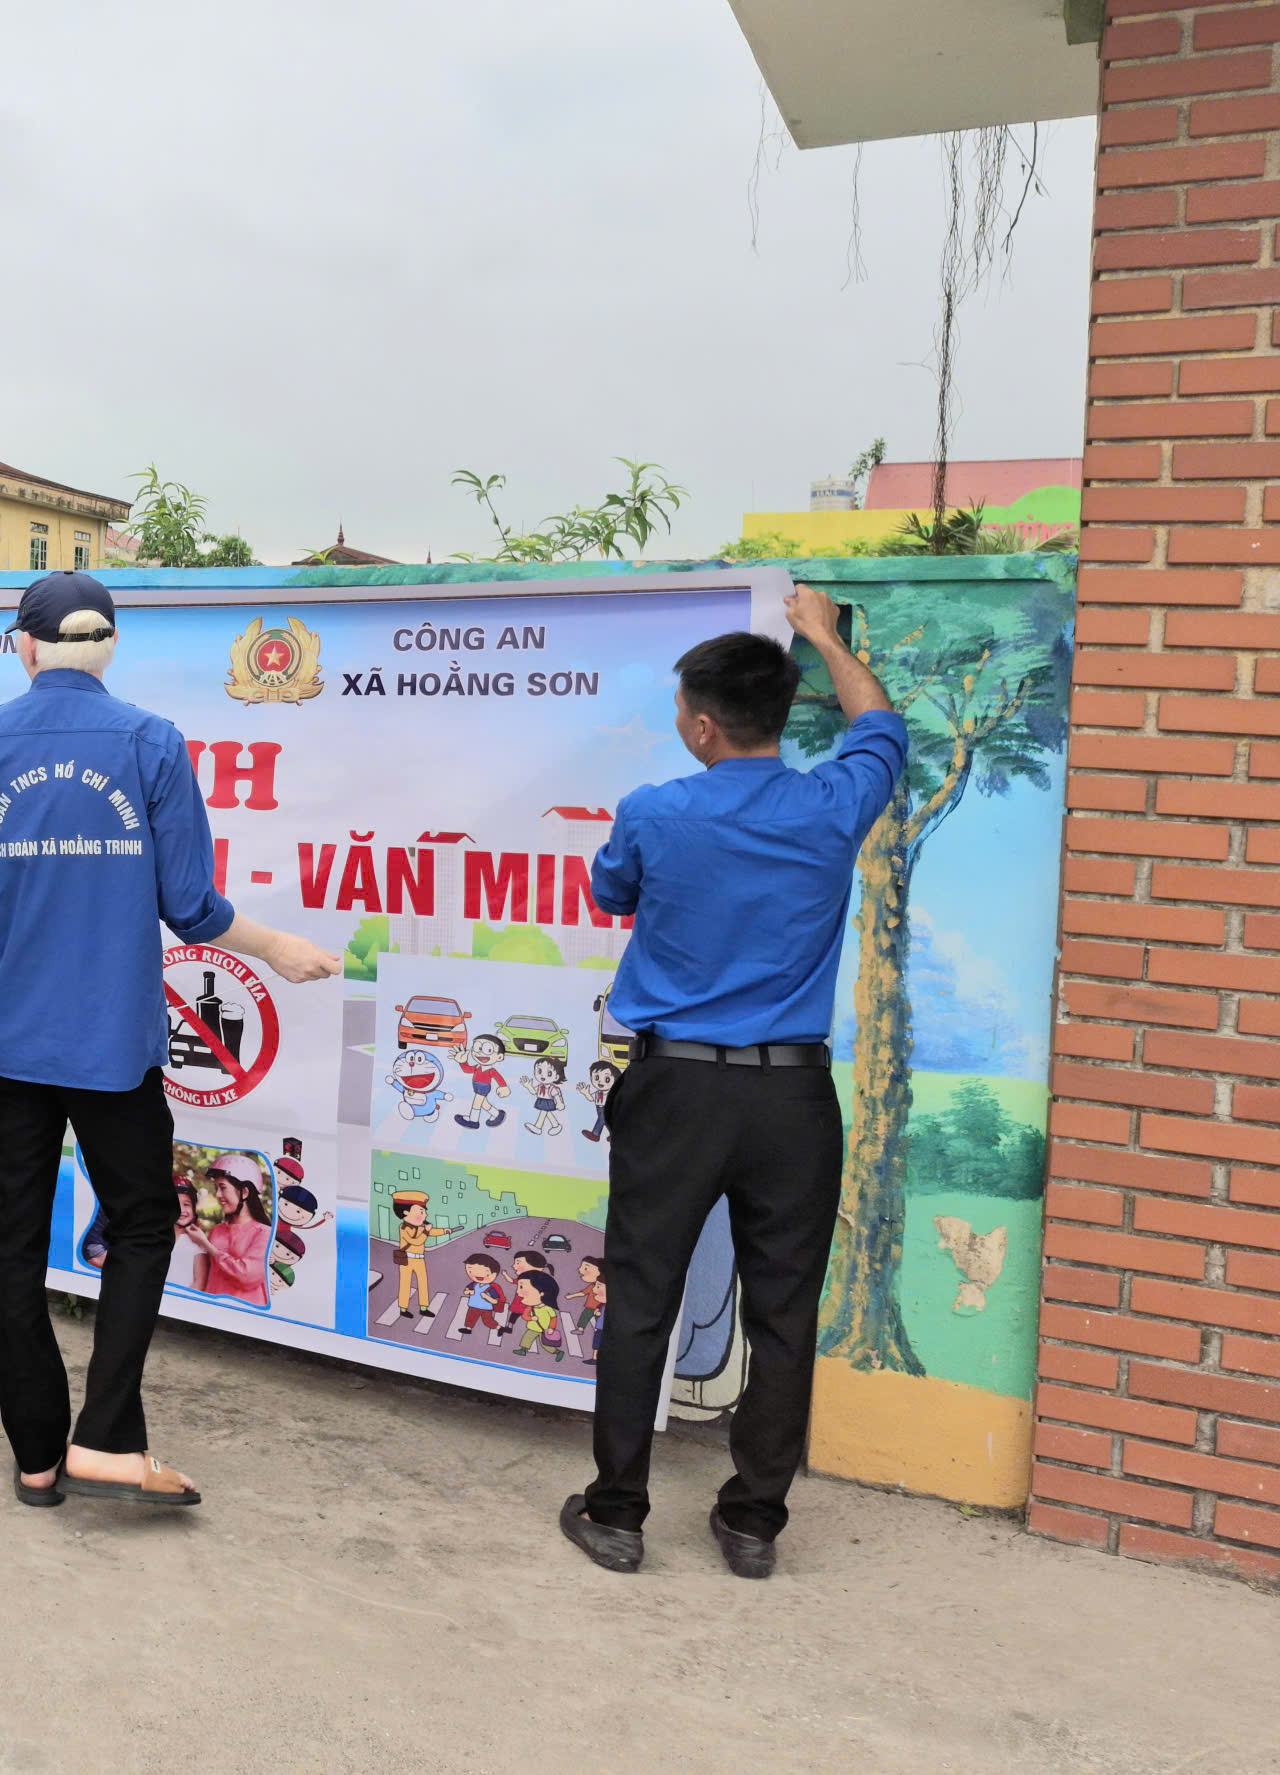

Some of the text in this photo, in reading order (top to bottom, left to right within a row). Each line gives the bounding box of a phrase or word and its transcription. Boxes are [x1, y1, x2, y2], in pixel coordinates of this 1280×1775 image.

[393, 622, 546, 651] CÔNG AN
[341, 660, 599, 697] XÃ HOẰNG SƠN
[9, 766, 48, 794] TNCS
[108, 788, 141, 831] MINH
[8, 838, 39, 857] ĐOÀN
[40, 837, 57, 856] XÃ
[59, 834, 102, 855] HOẰNG
[105, 839, 143, 855] TRINH
[297, 829, 435, 917] VĂN
[463, 849, 634, 930] MIN
[203, 1092, 221, 1106] LÁI
[221, 1088, 238, 1103] XE
